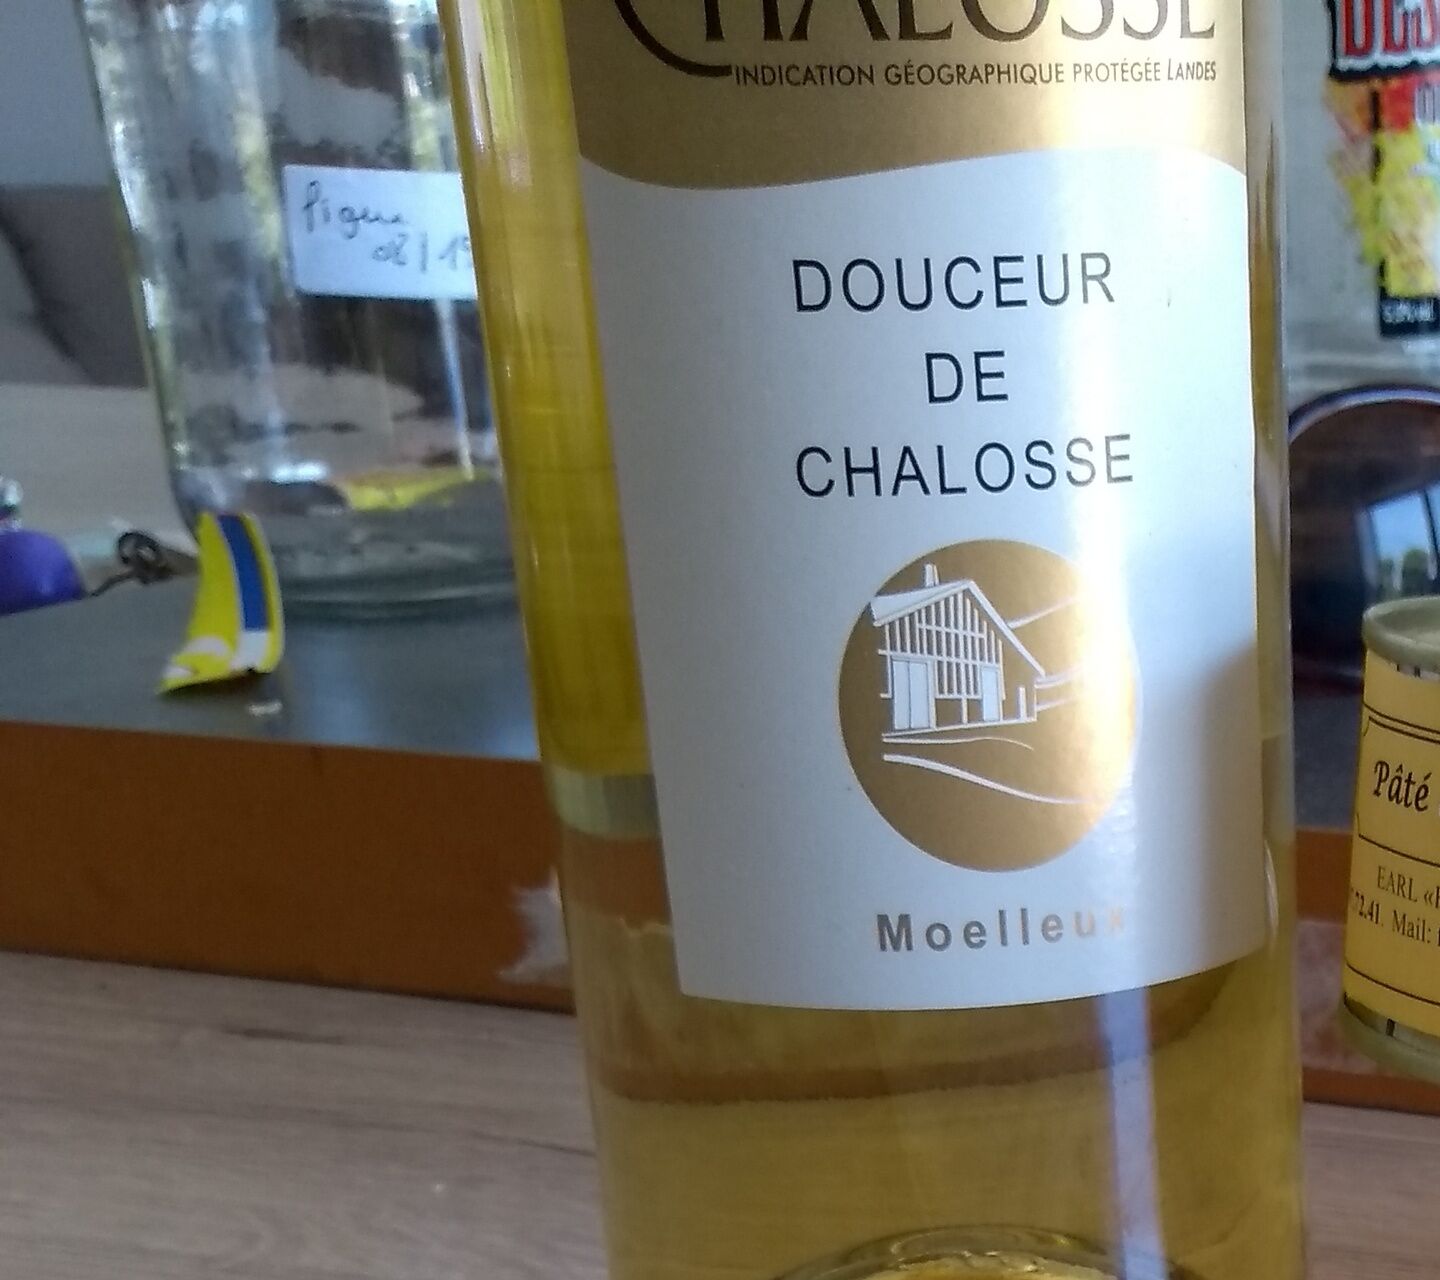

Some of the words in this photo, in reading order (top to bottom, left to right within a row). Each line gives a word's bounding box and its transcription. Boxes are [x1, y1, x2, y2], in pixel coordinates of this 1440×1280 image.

[735, 63, 874, 87] INDICATION
[884, 58, 1064, 86] GÉOGRAPHIQUE
[1073, 57, 1161, 82] PROTÉGÉE
[1167, 58, 1217, 82] LANDES
[792, 252, 1115, 313] DOUCEUR
[925, 350, 1009, 404] DE
[796, 434, 1134, 498] CHALOSSE
[1373, 760, 1433, 813] Pâté
[1377, 865, 1418, 902] EARL
[875, 905, 1125, 953] Moelleux
[1391, 909, 1432, 945] Mail:
